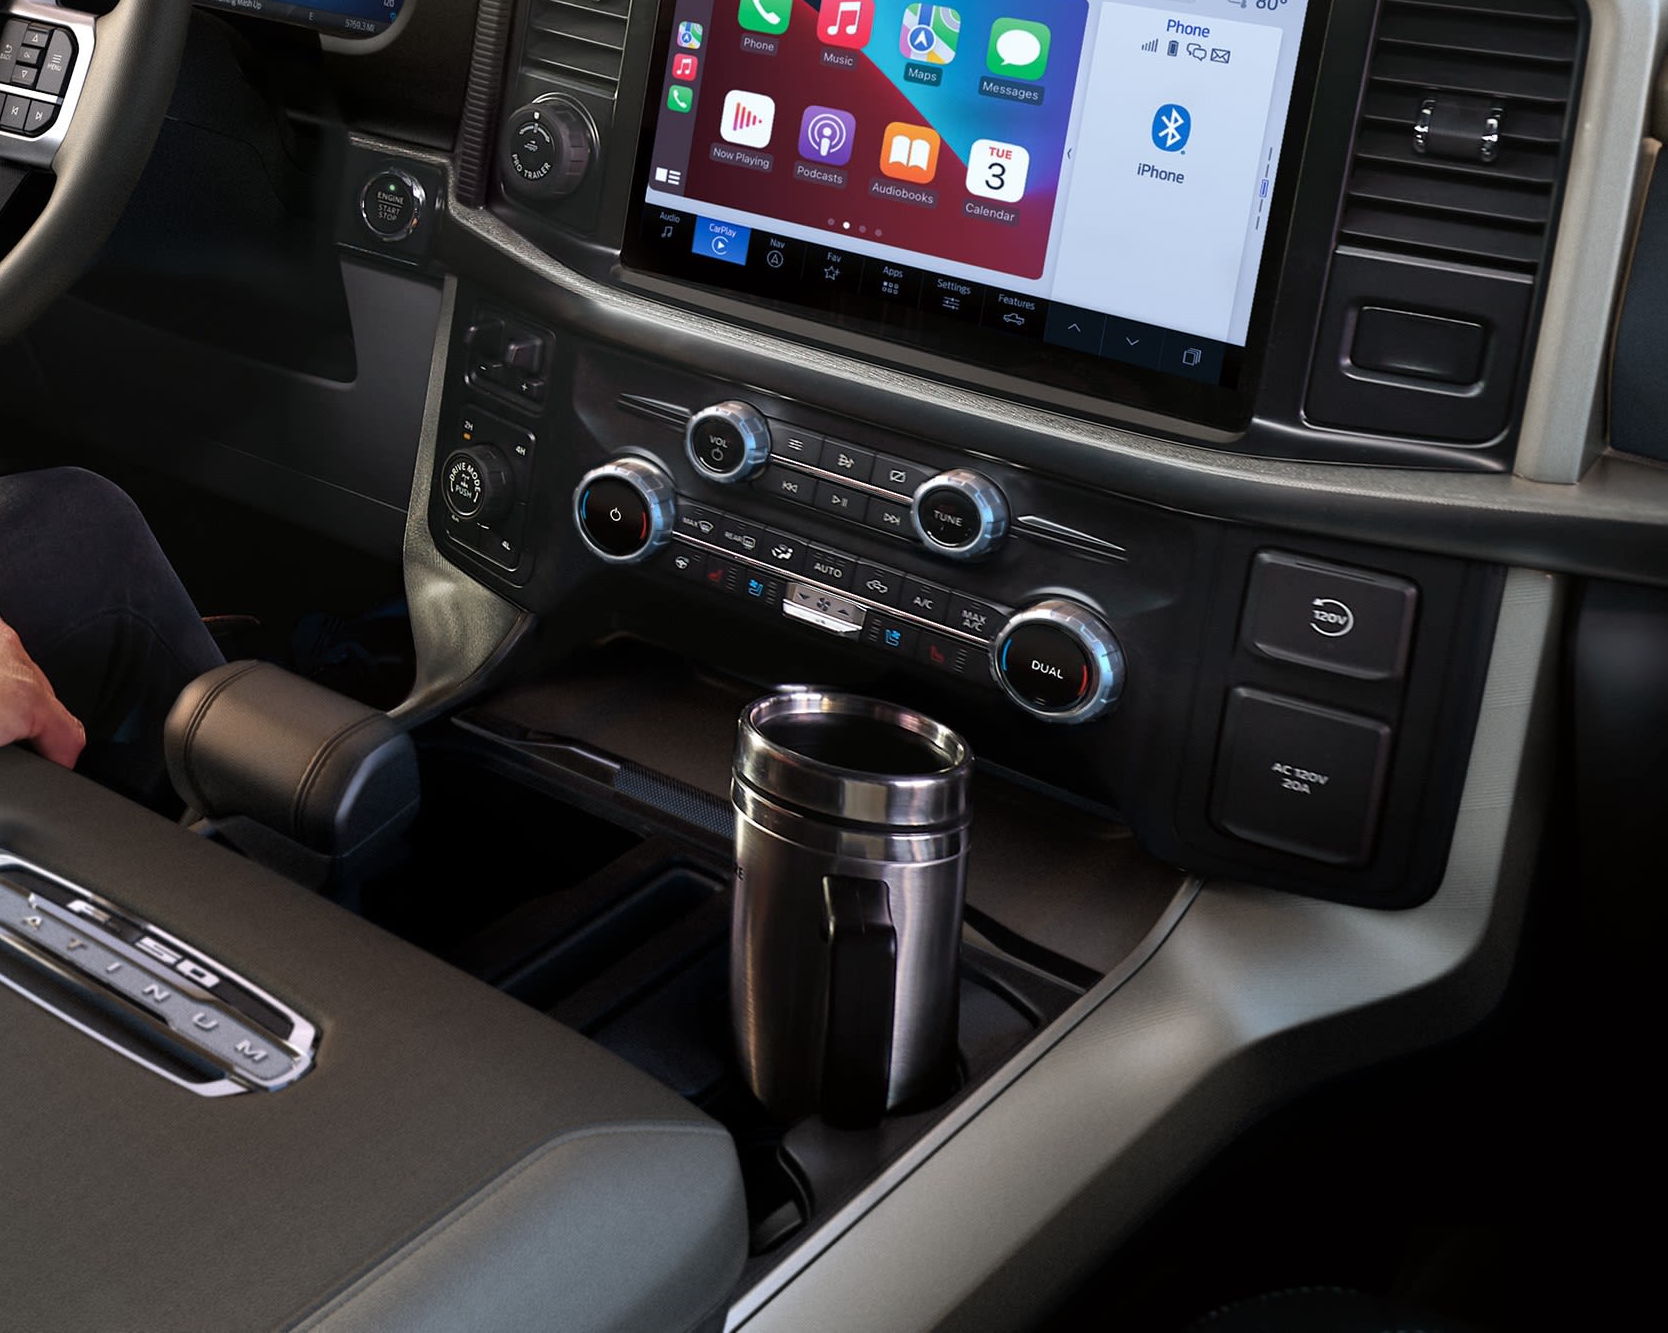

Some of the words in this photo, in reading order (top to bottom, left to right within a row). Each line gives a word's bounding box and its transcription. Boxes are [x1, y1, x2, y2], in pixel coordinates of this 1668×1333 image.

[253, 0, 262, 10] Up
[1165, 19, 1211, 38] Phone
[743, 38, 775, 53] Phone
[47, 63, 62, 71] MENU
[823, 52, 854, 67] Music
[908, 67, 938, 83] Maps
[982, 80, 1040, 102] Messages
[713, 146, 735, 160] Now
[736, 151, 770, 170] Playing
[988, 146, 1013, 161] TUE
[512, 153, 523, 172] PRO
[524, 162, 551, 179] TRAILER
[1137, 162, 1185, 184] iPhone
[797, 166, 843, 185] Podcasts
[985, 162, 1007, 191] 3
[377, 191, 404, 204] ENGINE
[871, 181, 934, 204] Audiobooks
[378, 203, 400, 215] START
[378, 211, 397, 221] STOP
[965, 203, 1015, 222] Calendar
[659, 211, 681, 223] Audio
[708, 223, 737, 238] CarPlay
[770, 238, 785, 249] Nav
[827, 251, 842, 263] Fav
[882, 266, 903, 279] Apps
[936, 278, 972, 295] Settings
[997, 293, 1036, 310] Features
[709, 434, 728, 449] VOL
[515, 446, 526, 456] 4H
[449, 462, 466, 482] DRIVE
[467, 465, 482, 493] MODE
[455, 484, 472, 499] PUSH
[682, 517, 699, 528] MAX
[933, 509, 963, 527] TUNE
[724, 531, 743, 543] REAR
[814, 562, 843, 578] AUTO
[913, 596, 933, 610] A/C
[962, 609, 987, 624] MAX
[1312, 609, 1348, 626] 120V
[962, 619, 983, 632] A/C
[1032, 660, 1064, 679] DUAL
[1271, 763, 1292, 776] AC
[1294, 767, 1329, 786] 120V
[1282, 778, 1311, 794] 20A
